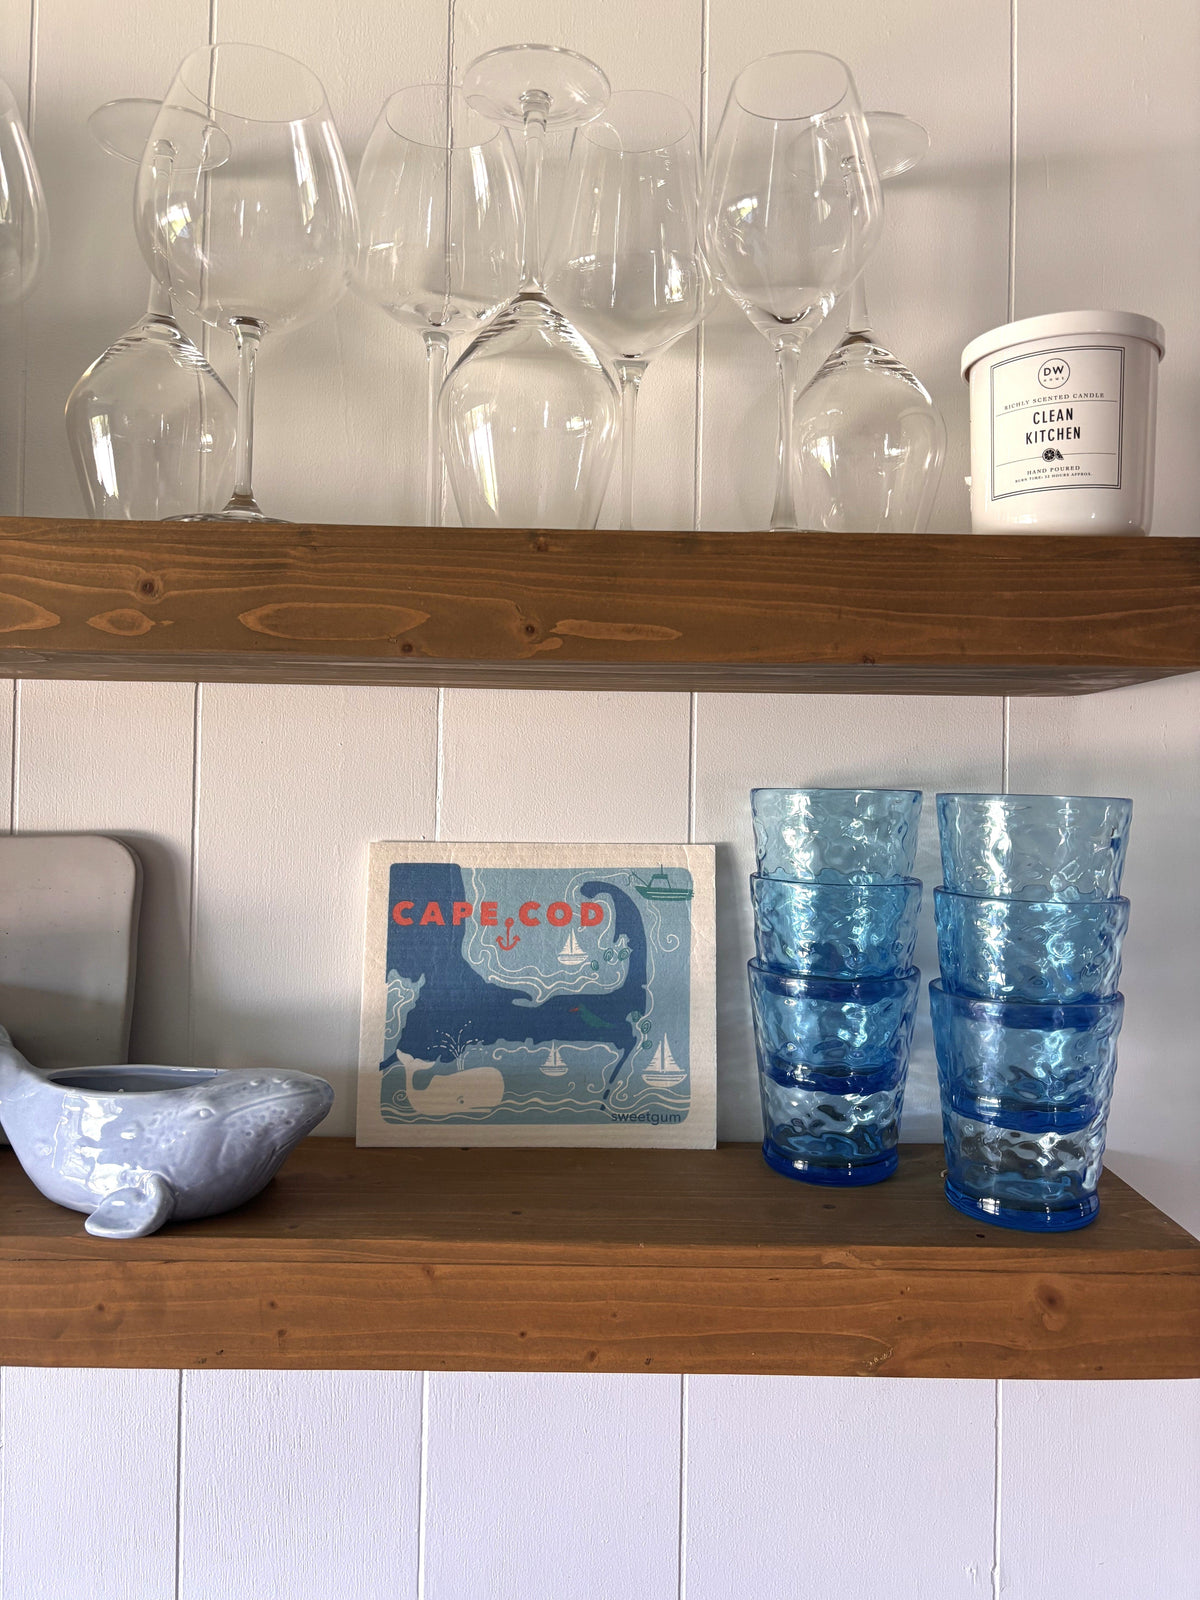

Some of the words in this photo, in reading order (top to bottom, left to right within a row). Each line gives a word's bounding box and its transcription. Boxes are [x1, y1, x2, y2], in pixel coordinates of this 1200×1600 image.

[1043, 365, 1064, 376] DW
[1004, 399, 1030, 410] RICHLY
[1033, 393, 1070, 404] SCENTED
[1032, 407, 1074, 425] CLEAN
[1025, 426, 1081, 445] KITCHEN
[1026, 468, 1047, 476] HAND
[391, 900, 498, 927] CAPE
[518, 901, 605, 927] COD
[611, 1111, 681, 1126] sweetgum
